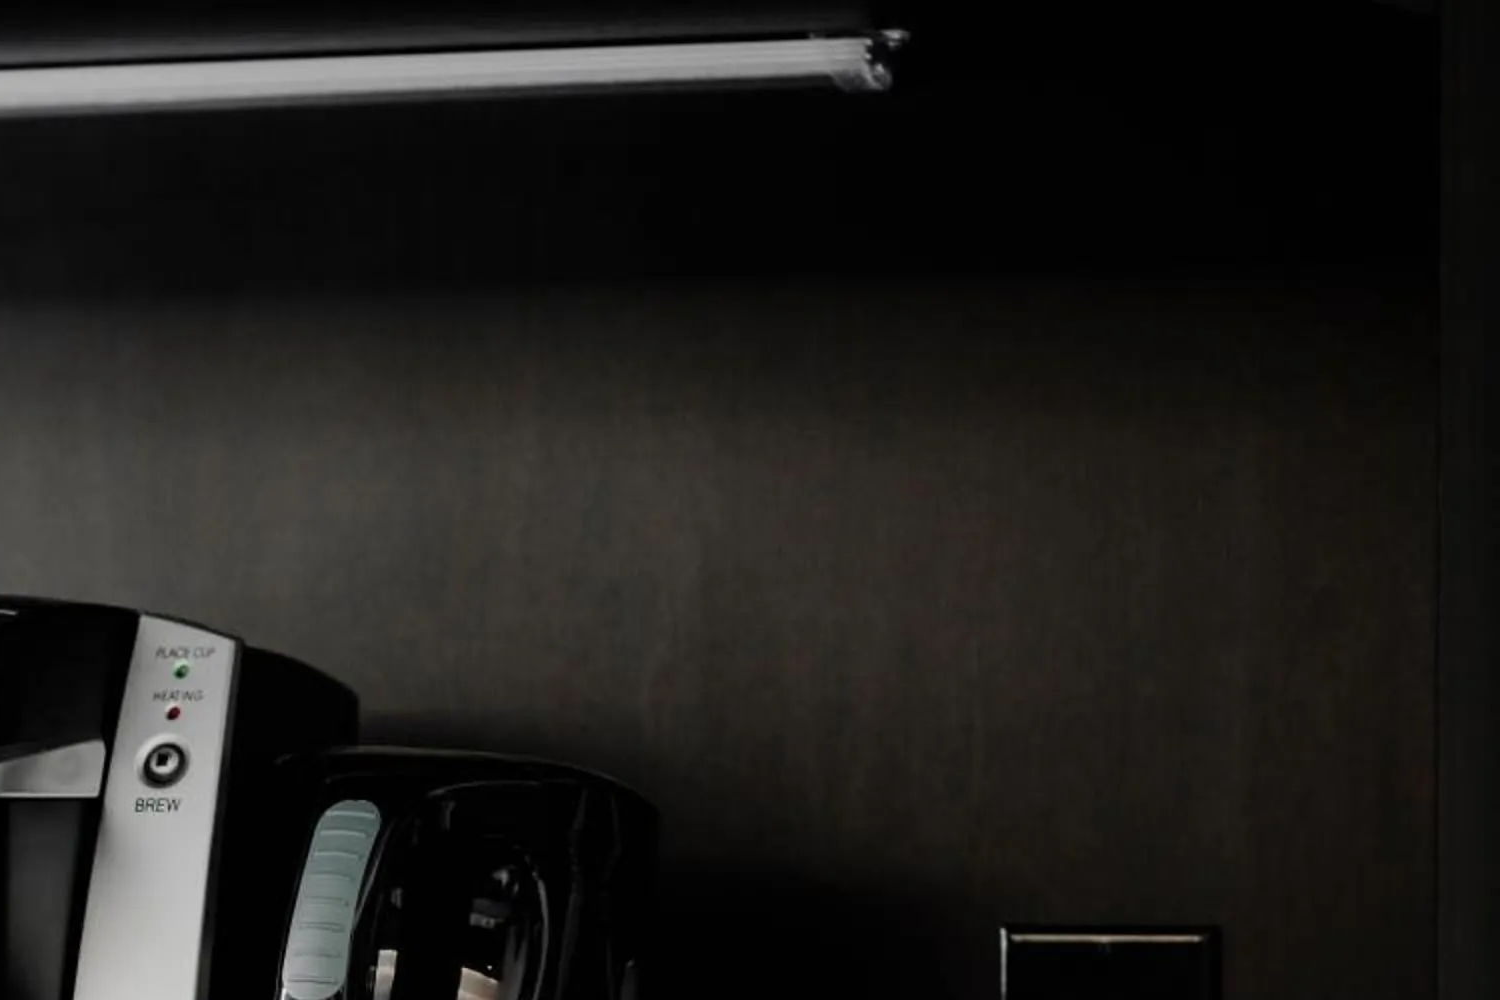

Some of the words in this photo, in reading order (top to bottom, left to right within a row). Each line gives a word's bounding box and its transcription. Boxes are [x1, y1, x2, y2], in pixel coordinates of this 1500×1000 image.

[155, 646, 190, 659] PLACE
[153, 688, 204, 702] HEATING
[134, 797, 182, 813] BREW
